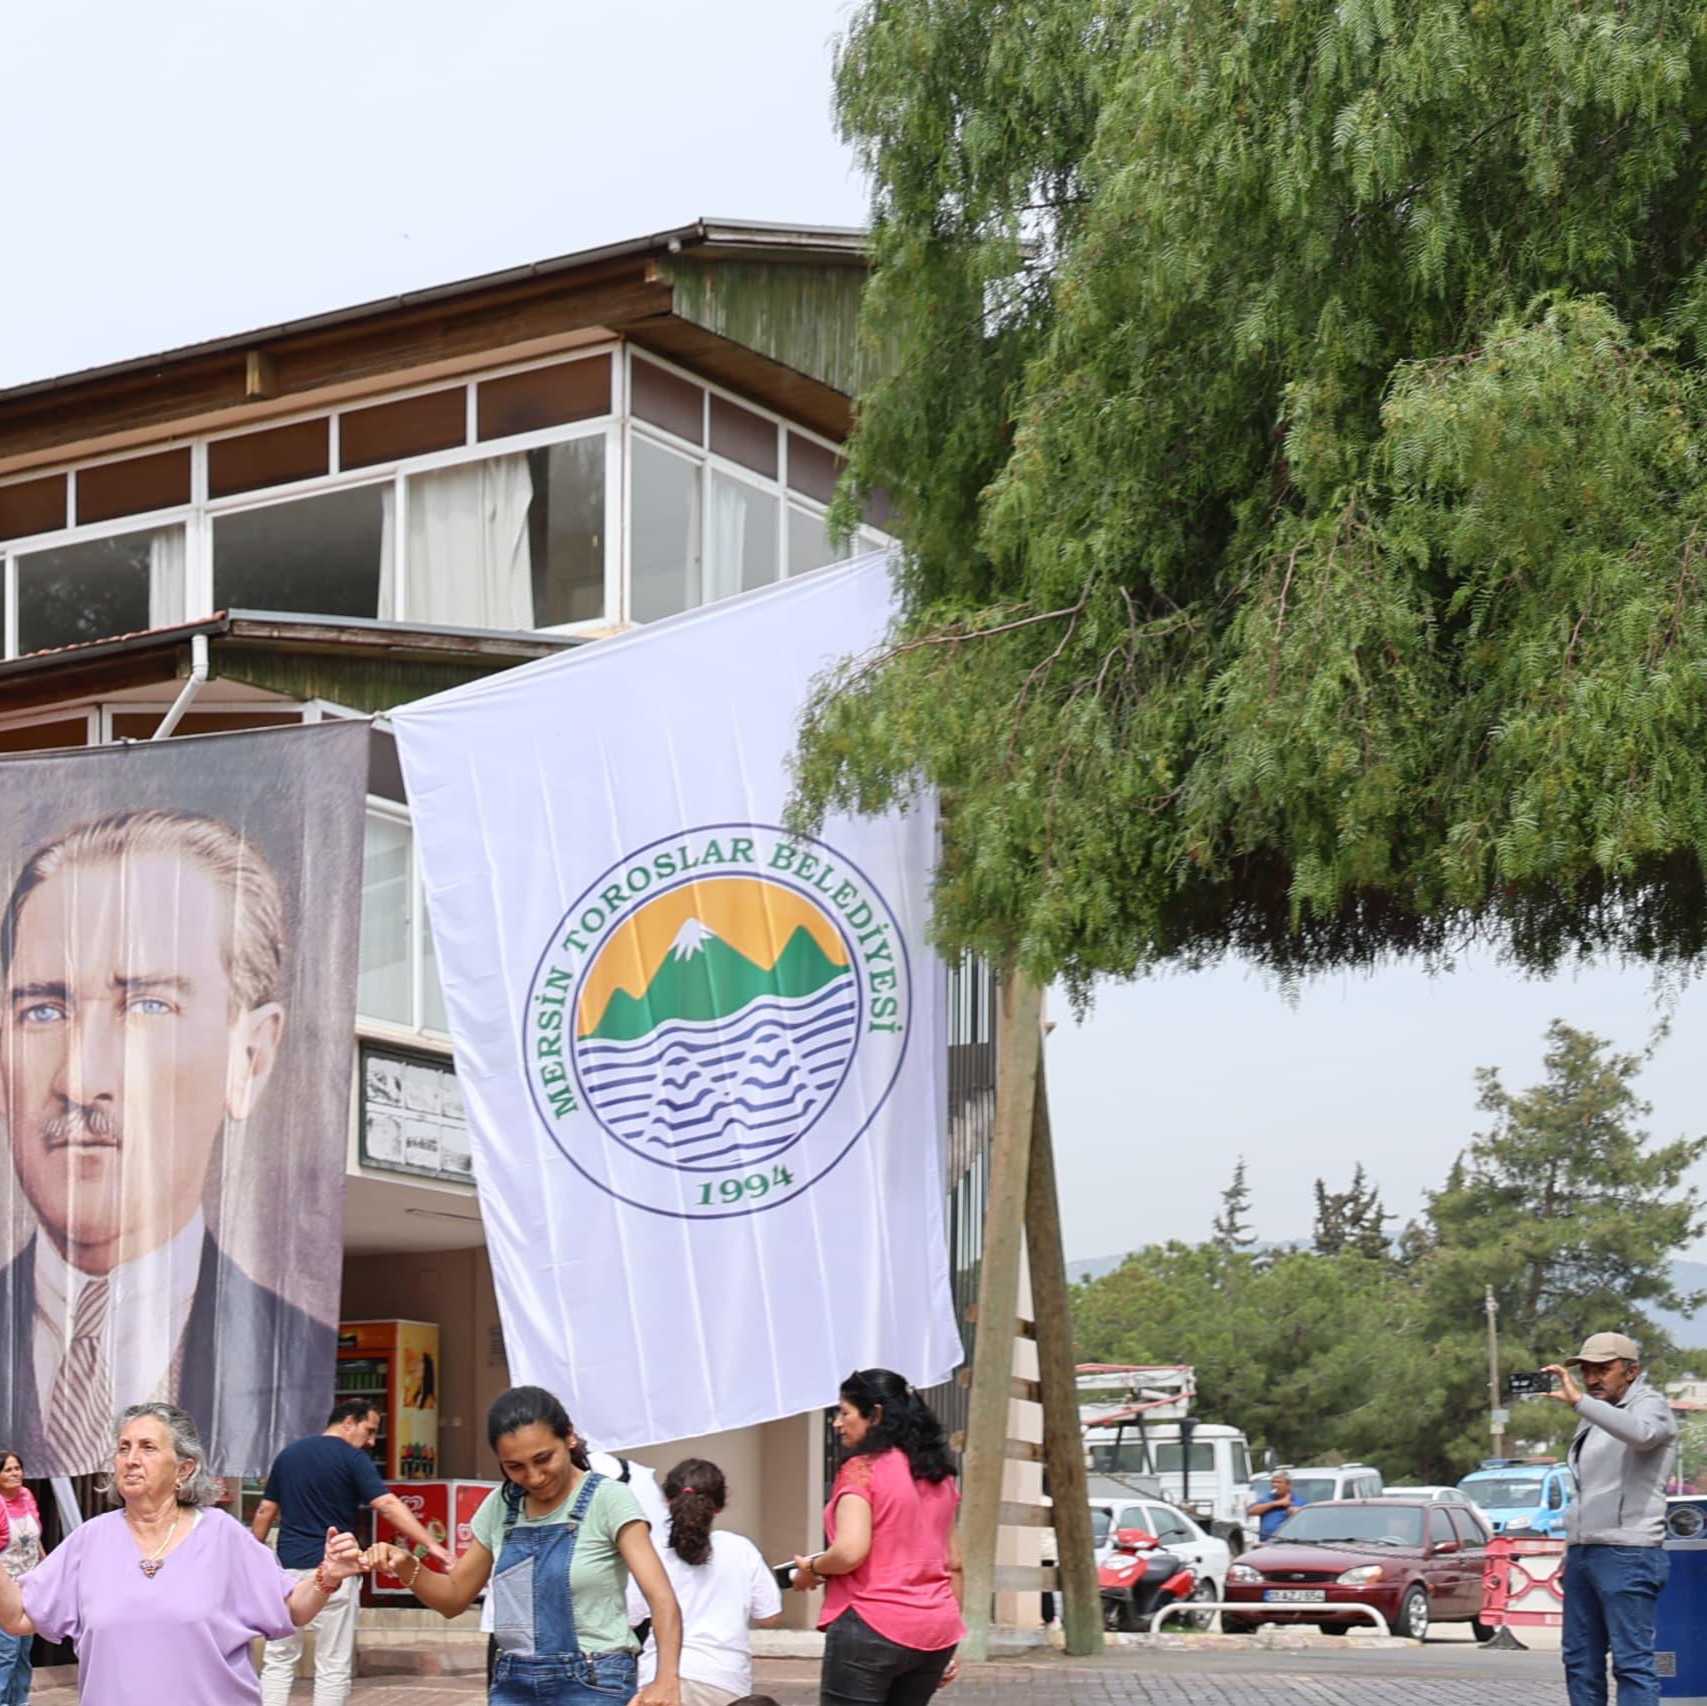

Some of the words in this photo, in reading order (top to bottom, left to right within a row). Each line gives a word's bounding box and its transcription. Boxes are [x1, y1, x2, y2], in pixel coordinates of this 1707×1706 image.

[535, 966, 580, 1120] MERSİN
[563, 838, 756, 955] TOROSLAR
[768, 842, 903, 1035] BELEDİYESİ
[697, 1163, 795, 1205] 1994
